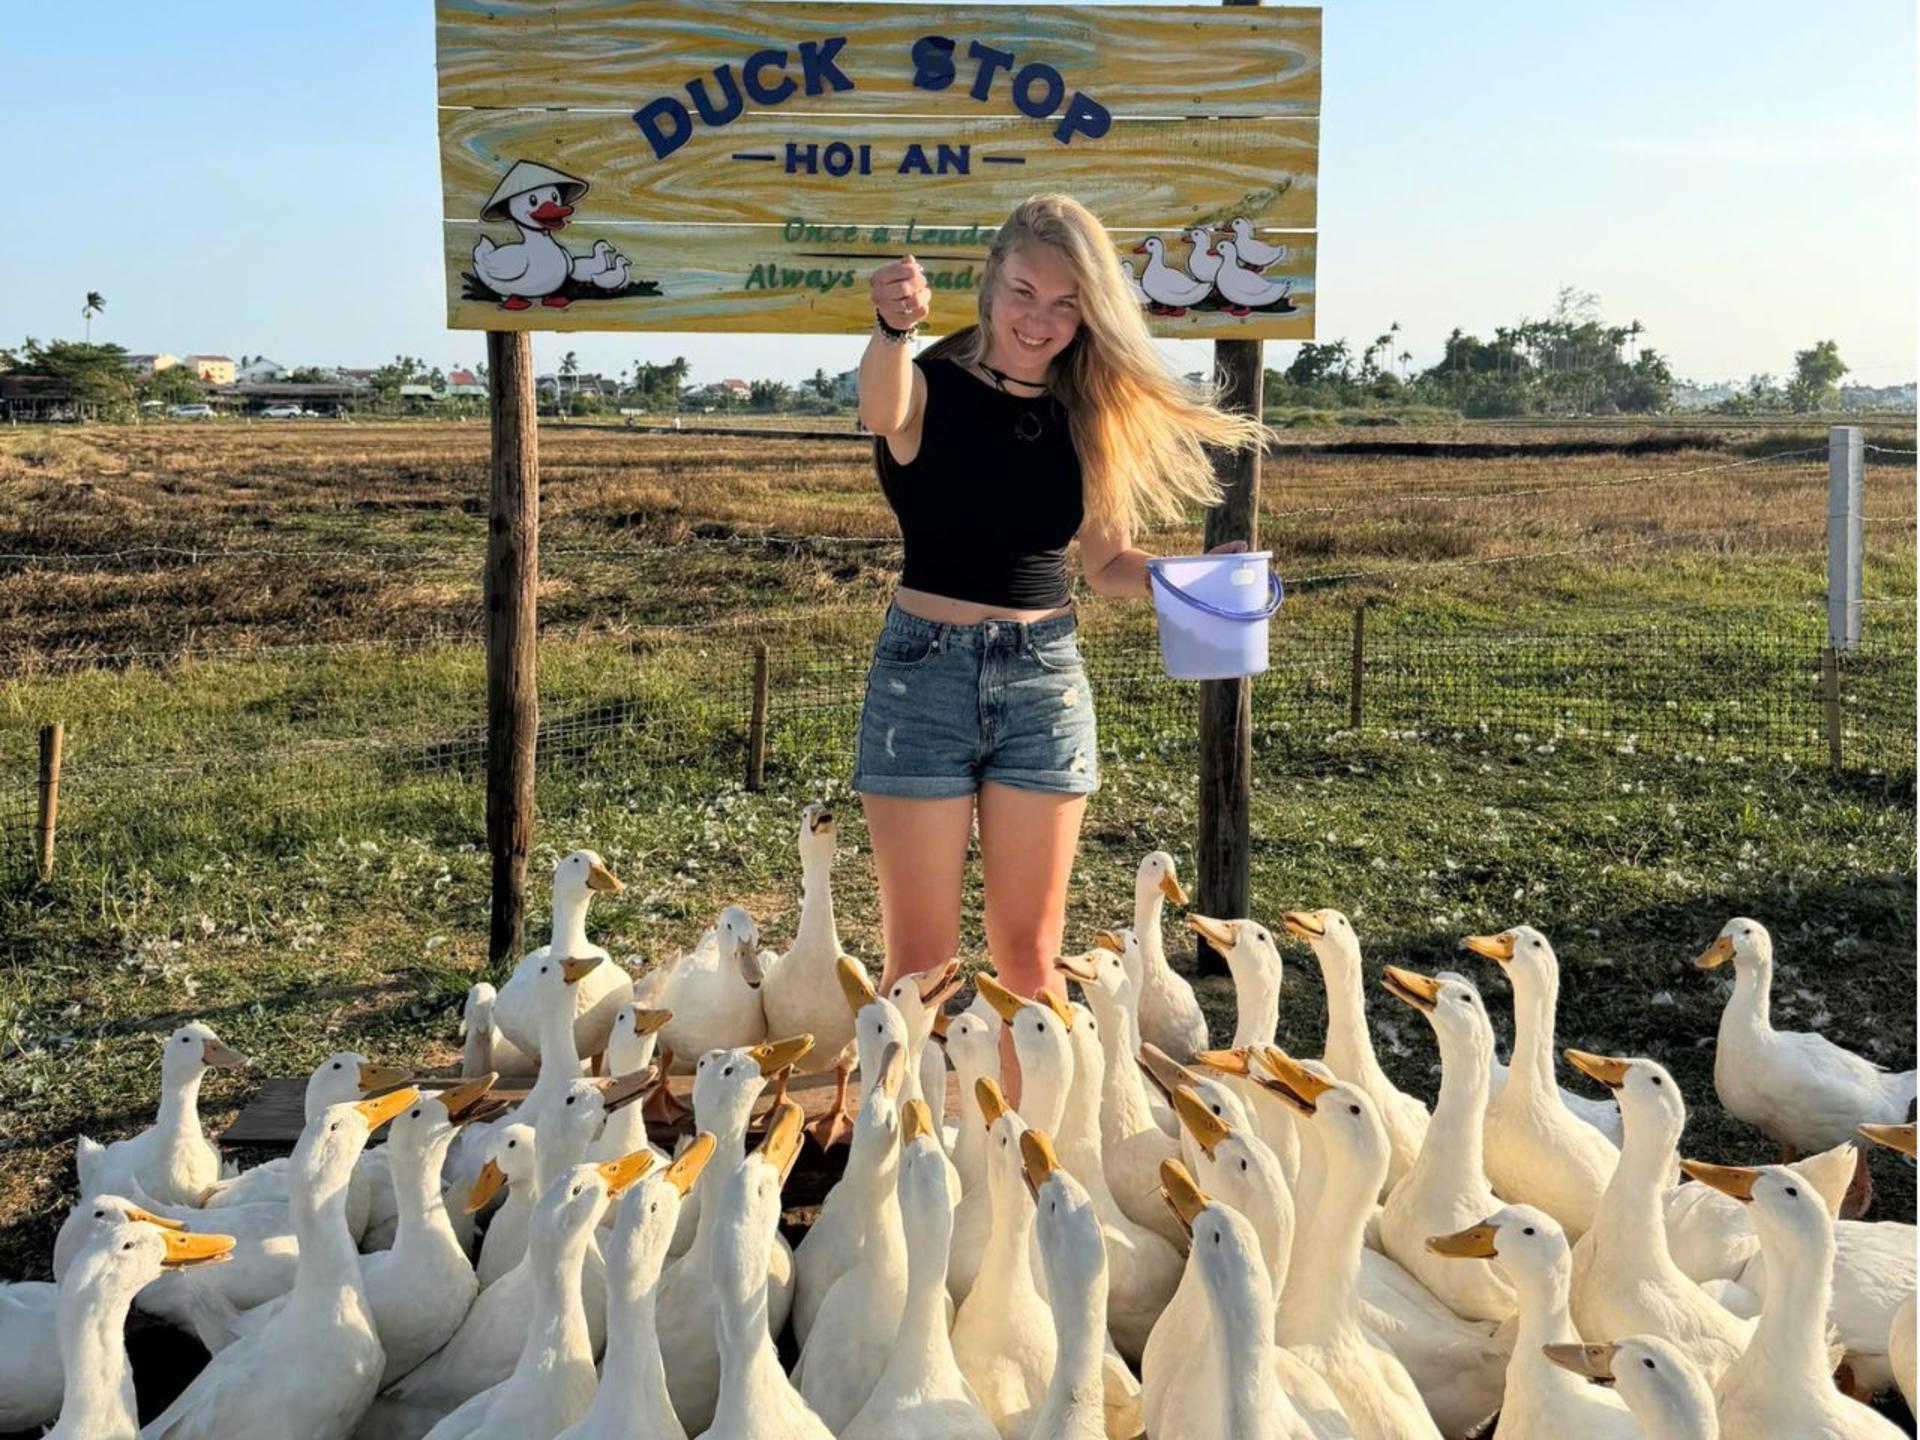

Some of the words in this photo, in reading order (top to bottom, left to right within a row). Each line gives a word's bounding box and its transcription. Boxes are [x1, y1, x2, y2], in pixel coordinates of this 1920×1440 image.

[632, 36, 855, 160] DUCK
[911, 36, 1112, 144] STOP
[785, 141, 872, 177] HOI
[897, 144, 971, 175] AN
[784, 216, 858, 244] Once
[873, 226, 889, 244] a
[906, 217, 998, 245] Leade
[744, 263, 855, 293] Always
